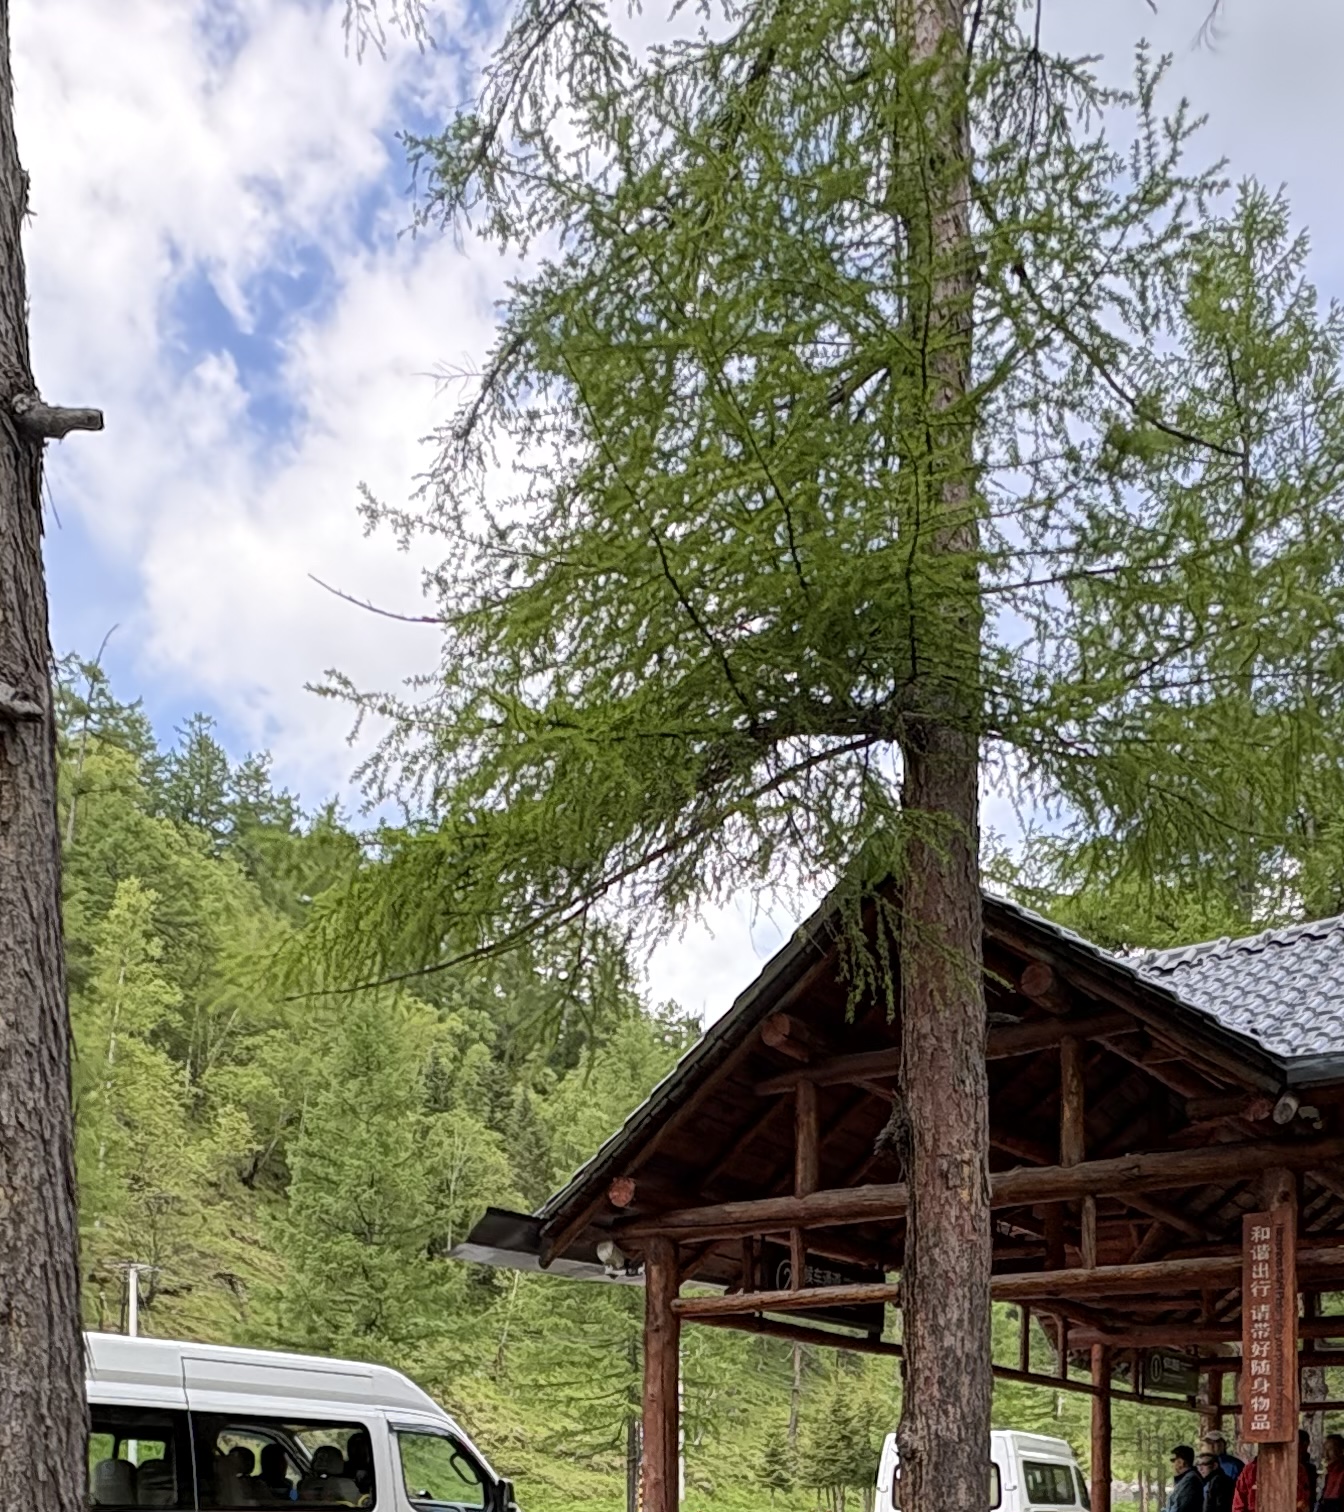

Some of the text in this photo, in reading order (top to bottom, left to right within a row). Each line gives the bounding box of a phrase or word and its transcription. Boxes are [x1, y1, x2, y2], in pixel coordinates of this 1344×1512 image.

[1250, 1226, 1271, 1431] 和谐出行 请带好随身物品
